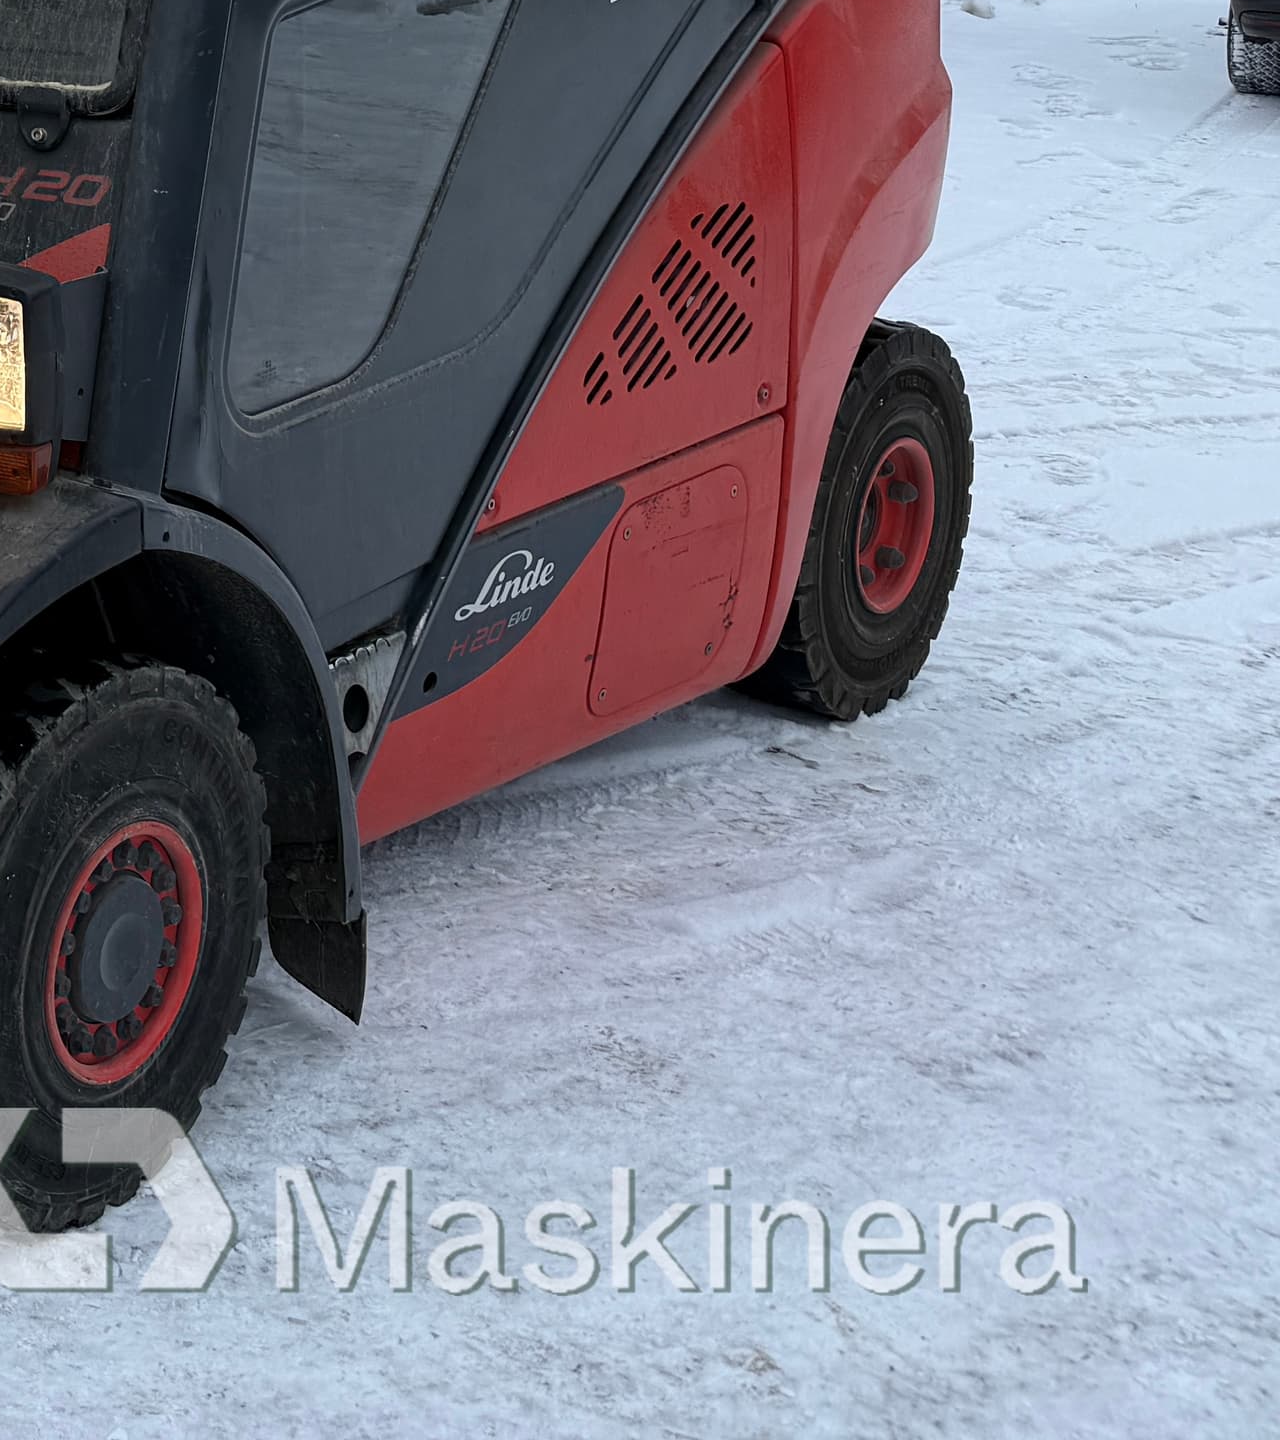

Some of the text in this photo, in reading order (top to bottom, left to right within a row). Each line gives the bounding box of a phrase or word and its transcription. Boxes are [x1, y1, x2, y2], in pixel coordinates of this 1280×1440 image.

[454, 550, 555, 621] Linde
[448, 607, 533, 662] H20 EVO
